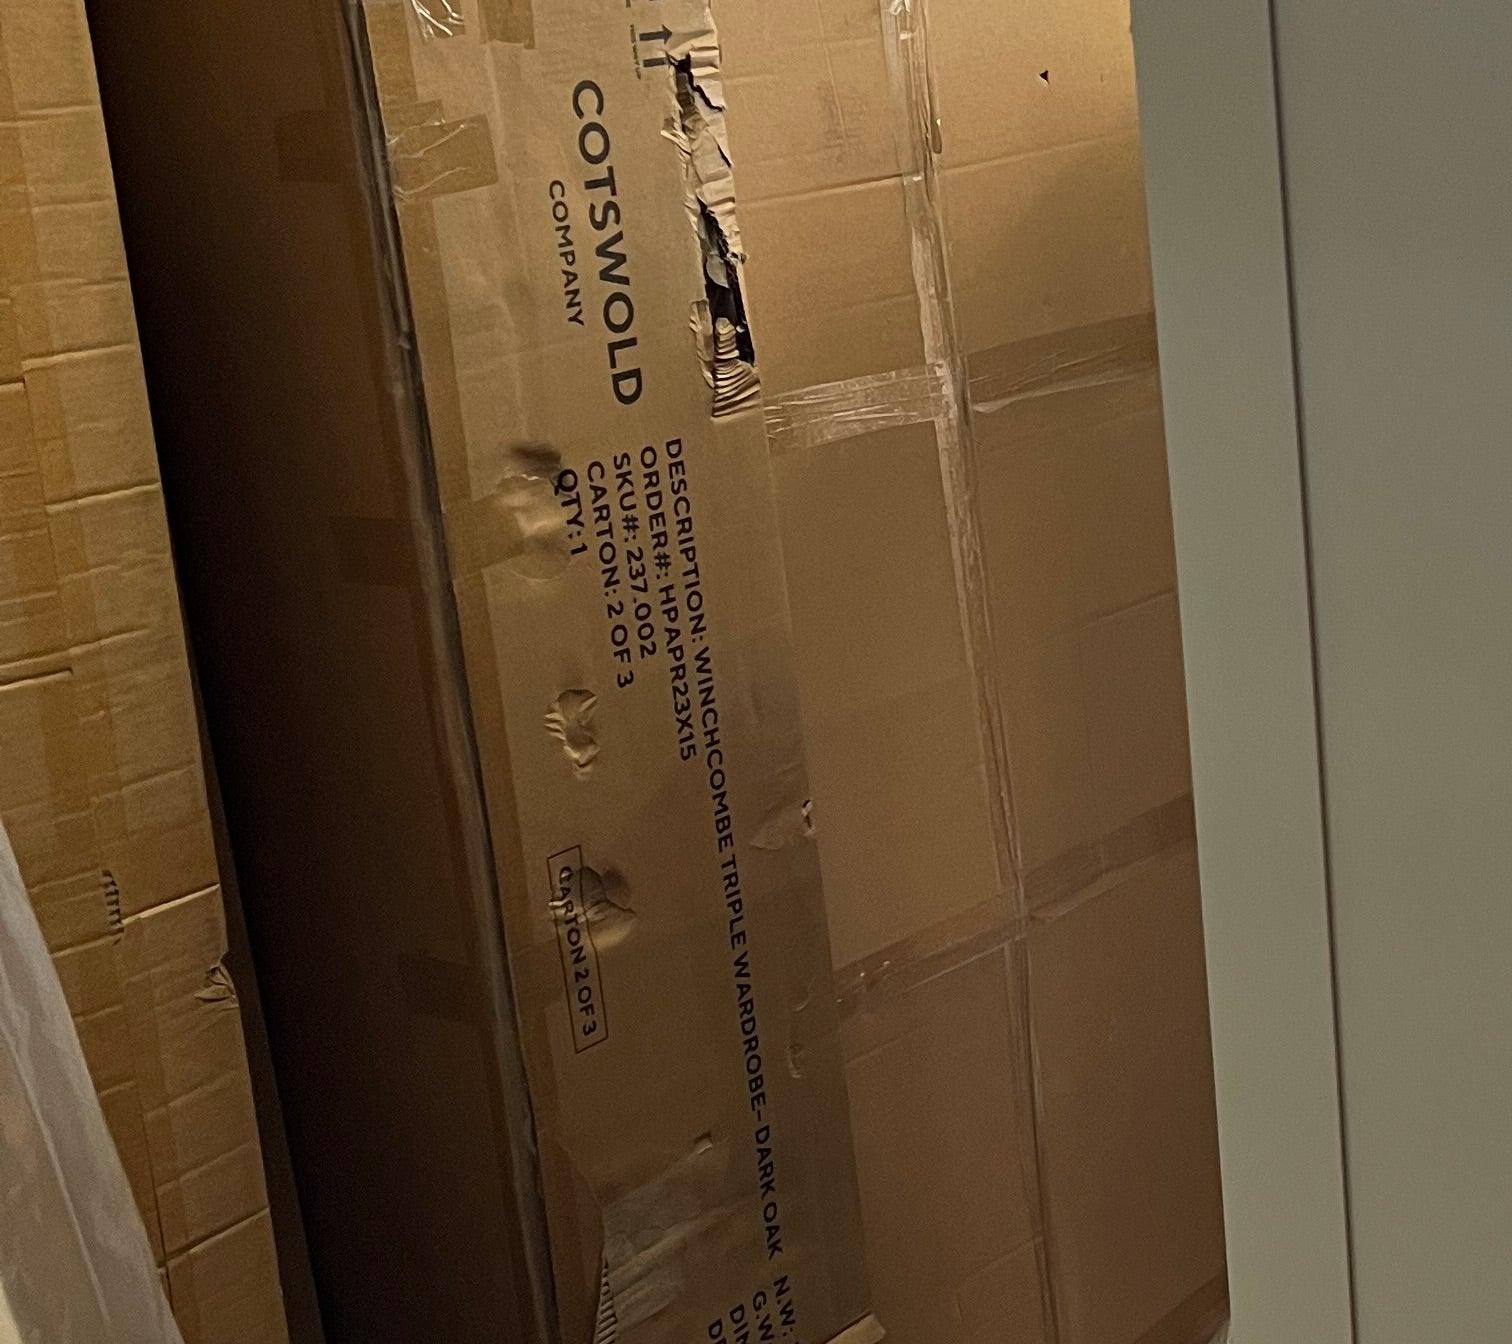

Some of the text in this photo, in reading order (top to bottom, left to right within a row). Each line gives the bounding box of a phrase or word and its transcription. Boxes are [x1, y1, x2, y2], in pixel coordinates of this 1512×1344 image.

[549, 179, 585, 327] COMPANY
[572, 79, 643, 405] COTSWOLD
[586, 460, 634, 689] CARTON: 2 OF 3
[613, 452, 657, 660] SKU#: 237.002
[640, 445, 697, 762] ORDER#: HPAPR23X15
[559, 865, 597, 1037] CARTON 2 OF 3
[665, 438, 707, 644] DESCRIPTION:
[694, 646, 734, 853] WINCHCOMBE
[720, 854, 747, 951] TRIPLE
[763, 1201, 783, 1260] OAK
[773, 1273, 800, 1337] N.W:
